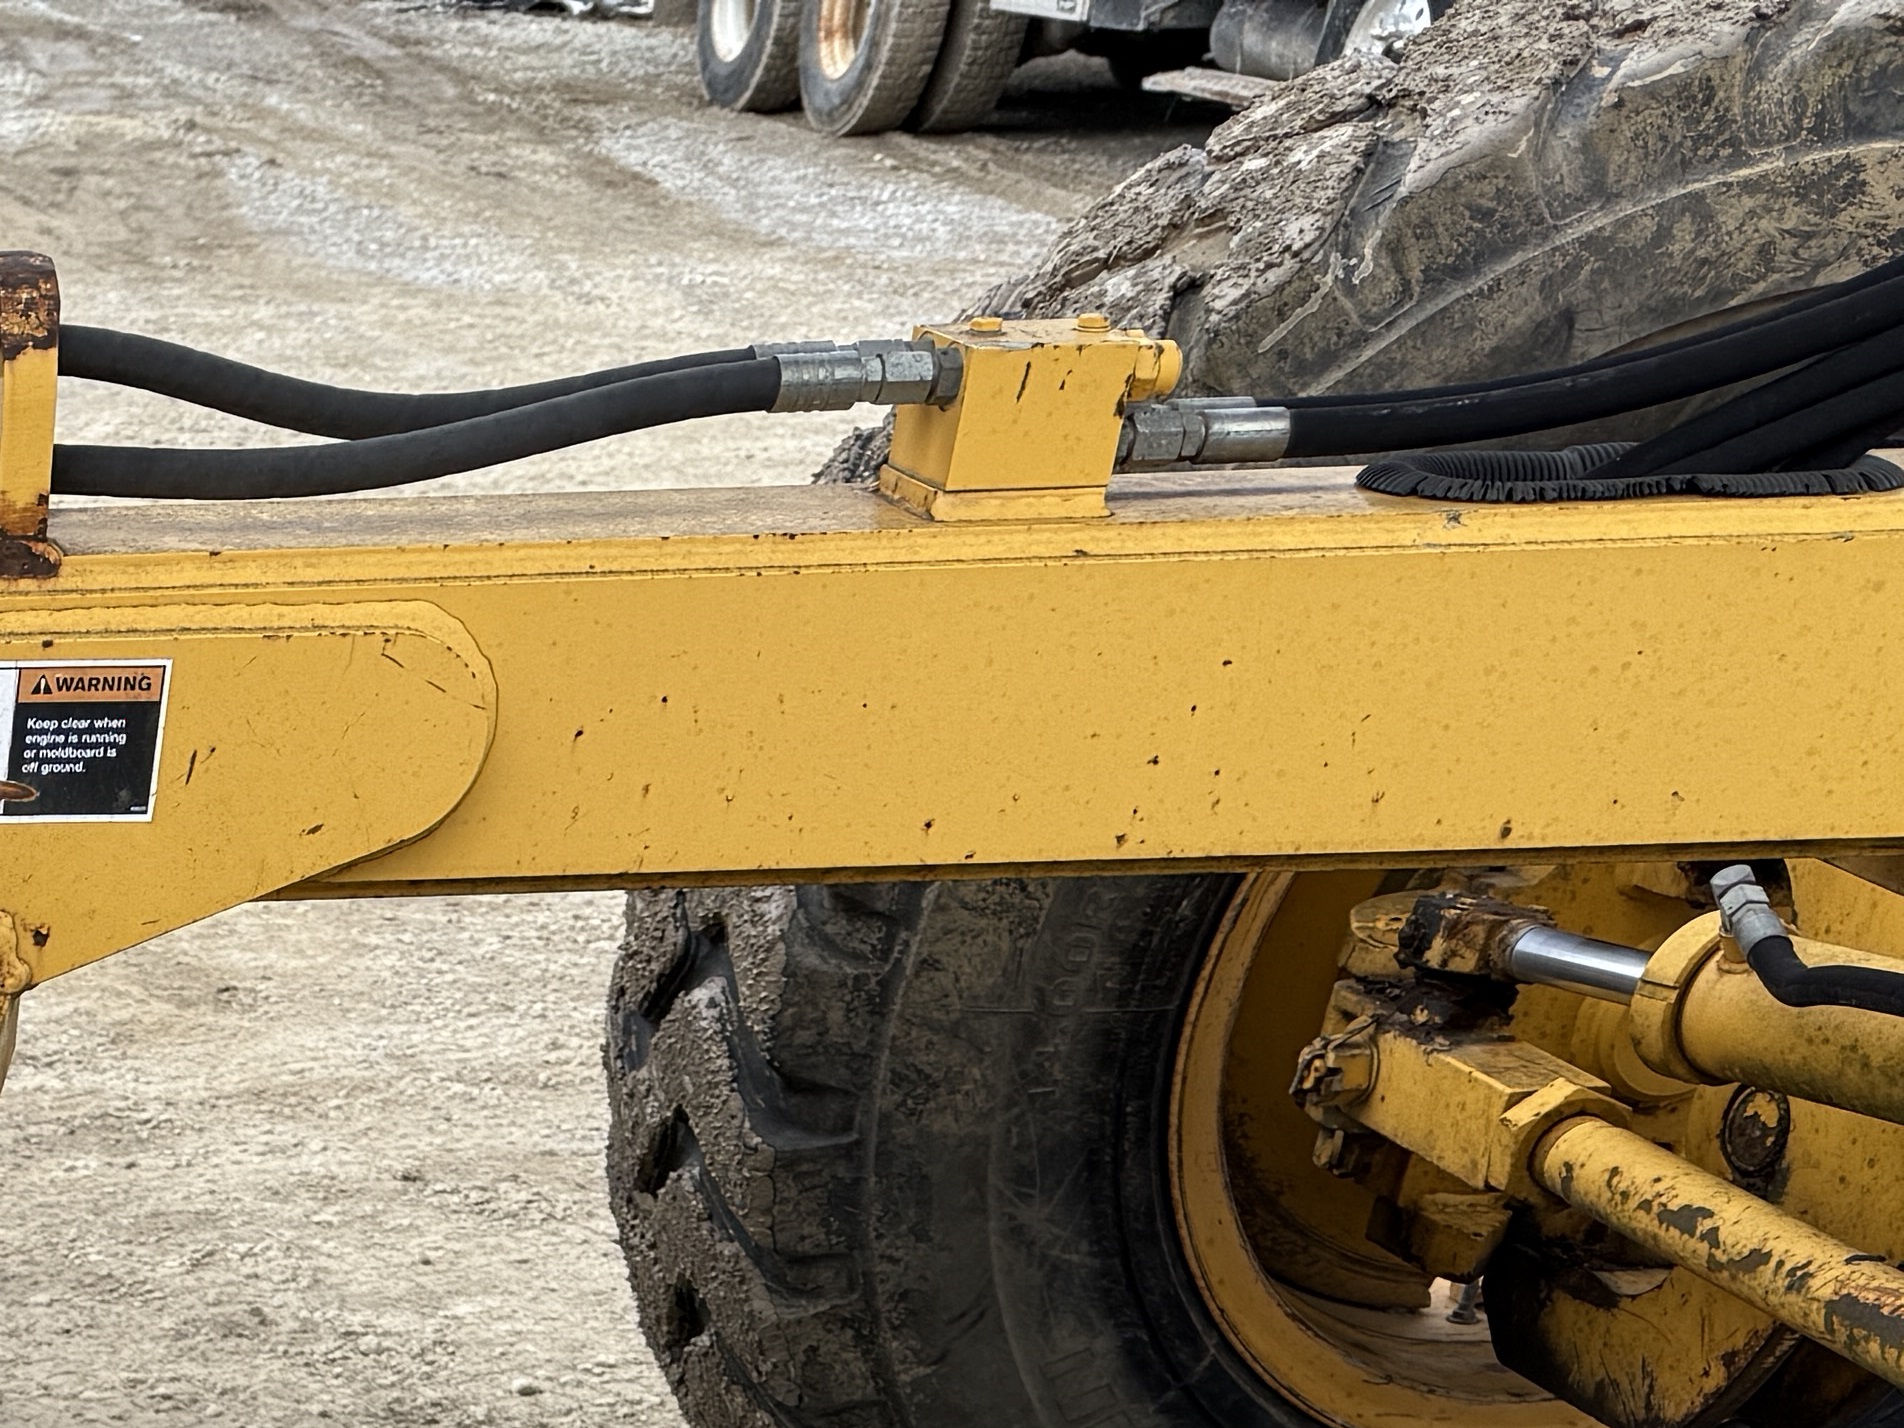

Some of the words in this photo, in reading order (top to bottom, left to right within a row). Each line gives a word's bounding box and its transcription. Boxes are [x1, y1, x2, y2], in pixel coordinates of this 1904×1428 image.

[55, 676, 152, 692] WARNING
[27, 718, 58, 730] Keep
[61, 717, 90, 729] clear
[93, 717, 126, 728] when
[25, 733, 65, 746] engine
[68, 732, 78, 743] is
[81, 732, 127, 744] running
[23, 749, 36, 758] or
[39, 747, 104, 758] moldboard
[106, 747, 117, 757] is
[21, 762, 38, 773] off
[41, 762, 86, 775] ground.
